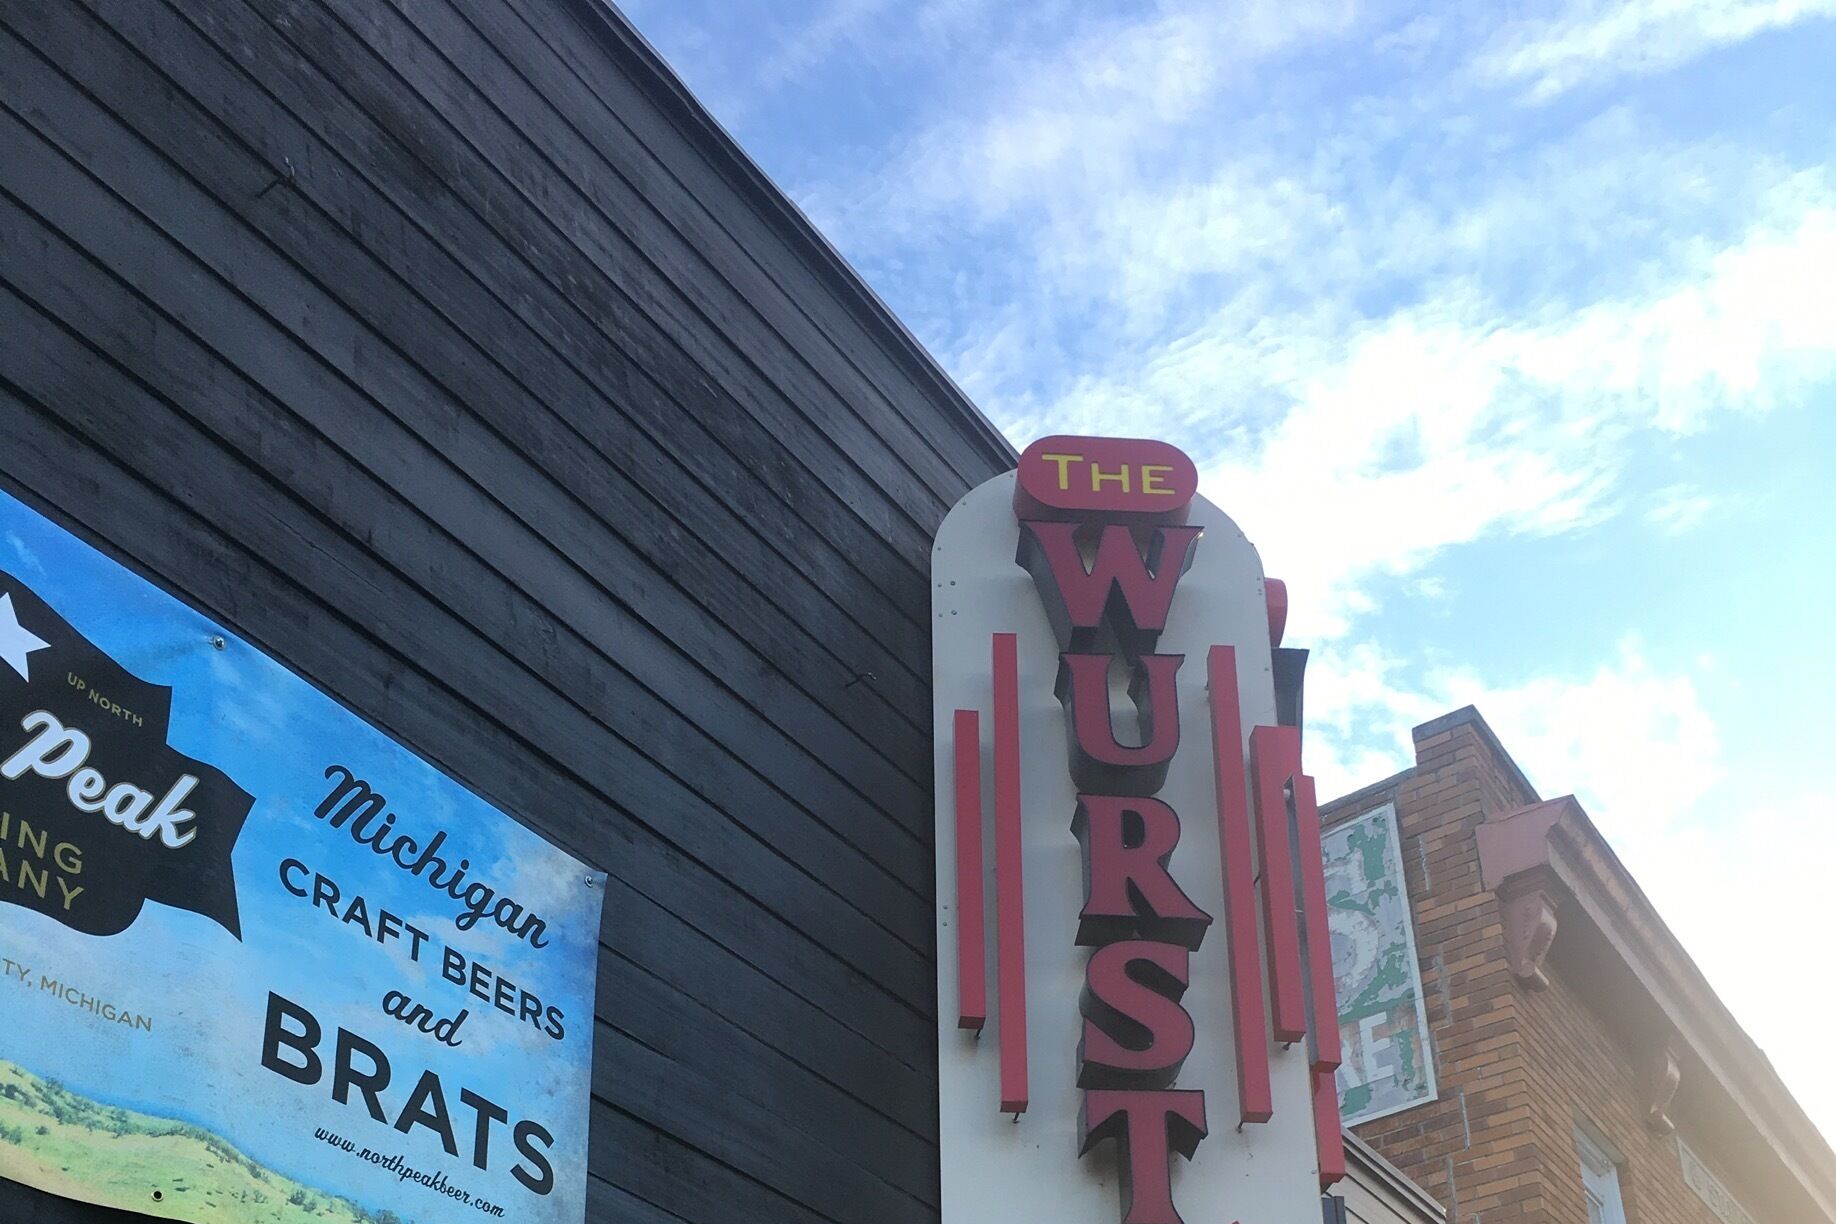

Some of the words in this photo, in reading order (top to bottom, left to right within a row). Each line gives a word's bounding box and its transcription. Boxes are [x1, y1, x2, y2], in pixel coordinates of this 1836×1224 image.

[1041, 453, 1176, 495] THE
[67, 671, 86, 691] UP
[88, 689, 143, 728] NORTH
[0, 708, 200, 849] Peak
[313, 764, 549, 949] Michigan
[279, 858, 429, 962] CRAFT
[442, 945, 565, 1040] BEERS
[40, 975, 152, 1032] MICHIGAN
[381, 990, 470, 1047] and
[261, 990, 555, 1196] BRATS
[314, 1125, 506, 1218] www.northpeakbeer.com
